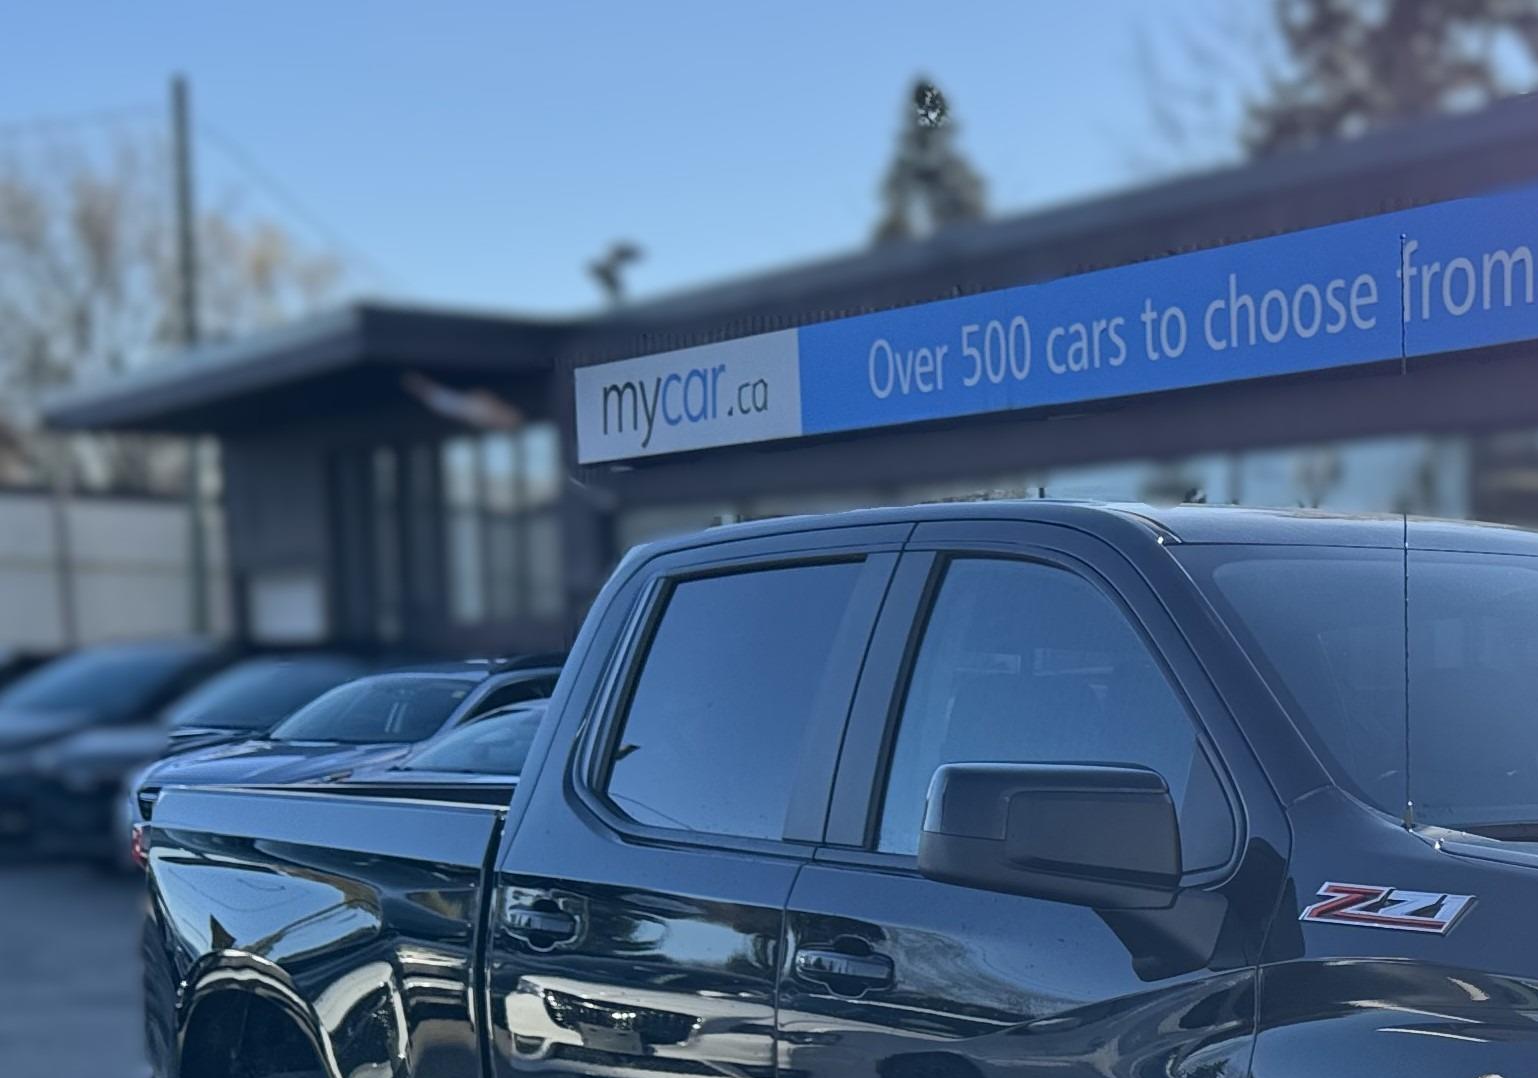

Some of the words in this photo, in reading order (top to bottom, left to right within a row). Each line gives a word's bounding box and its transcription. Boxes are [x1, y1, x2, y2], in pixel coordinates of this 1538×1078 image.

[868, 337, 948, 400] Over
[960, 314, 1032, 388] 500
[1046, 312, 1127, 375] cars
[1141, 298, 1188, 361] to
[1203, 273, 1378, 351] choose
[601, 362, 769, 449] mycar.ca
[1298, 881, 1476, 934] Z71
